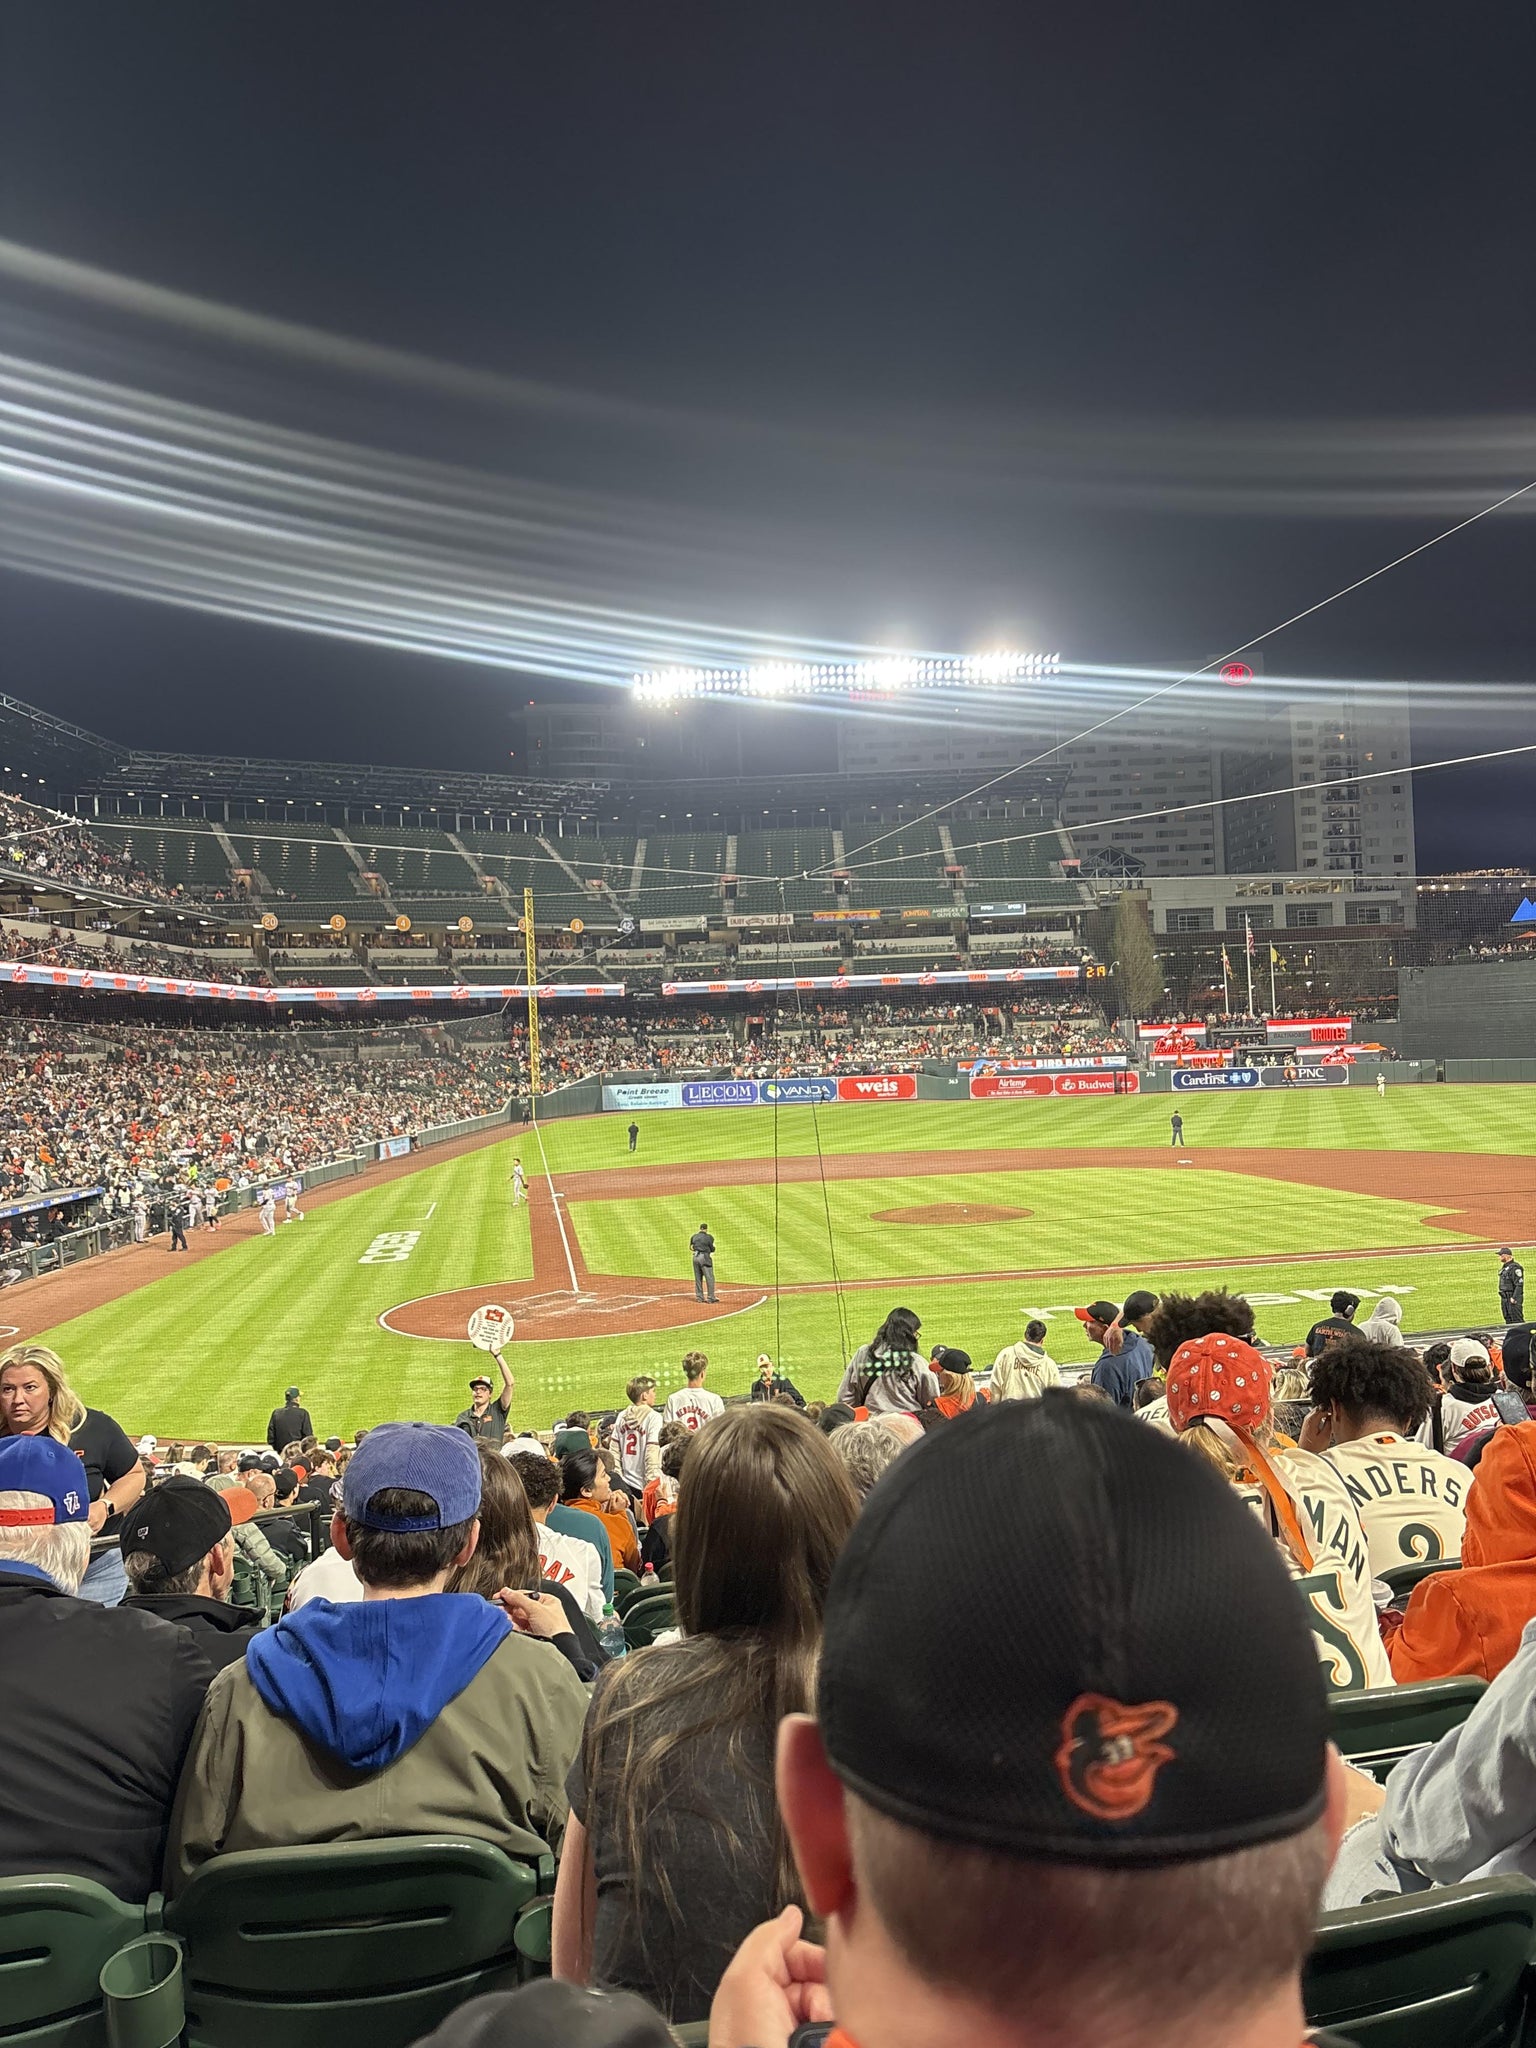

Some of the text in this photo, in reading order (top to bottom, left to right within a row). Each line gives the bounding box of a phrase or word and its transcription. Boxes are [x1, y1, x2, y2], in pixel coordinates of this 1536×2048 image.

[264, 916, 276, 926] 20
[335, 919, 341, 928] 5
[400, 919, 406, 928] 4
[460, 920, 472, 929] 22
[574, 921, 580, 930] 8
[622, 921, 632, 930] 42
[1311, 1028, 1347, 1042] ORIOLES
[1036, 1058, 1063, 1068] BIRD
[1065, 1056, 1094, 1067] BATH
[1298, 1067, 1325, 1078] PNC
[998, 1078, 1027, 1088] Airtemp
[1078, 1079, 1133, 1090] Budweer
[1181, 1073, 1229, 1086] CareFirst
[855, 1078, 899, 1093] weis
[689, 1085, 752, 1099] LECOM
[626, 1433, 638, 1456] 2
[1345, 1463, 1462, 1508] NDERS
